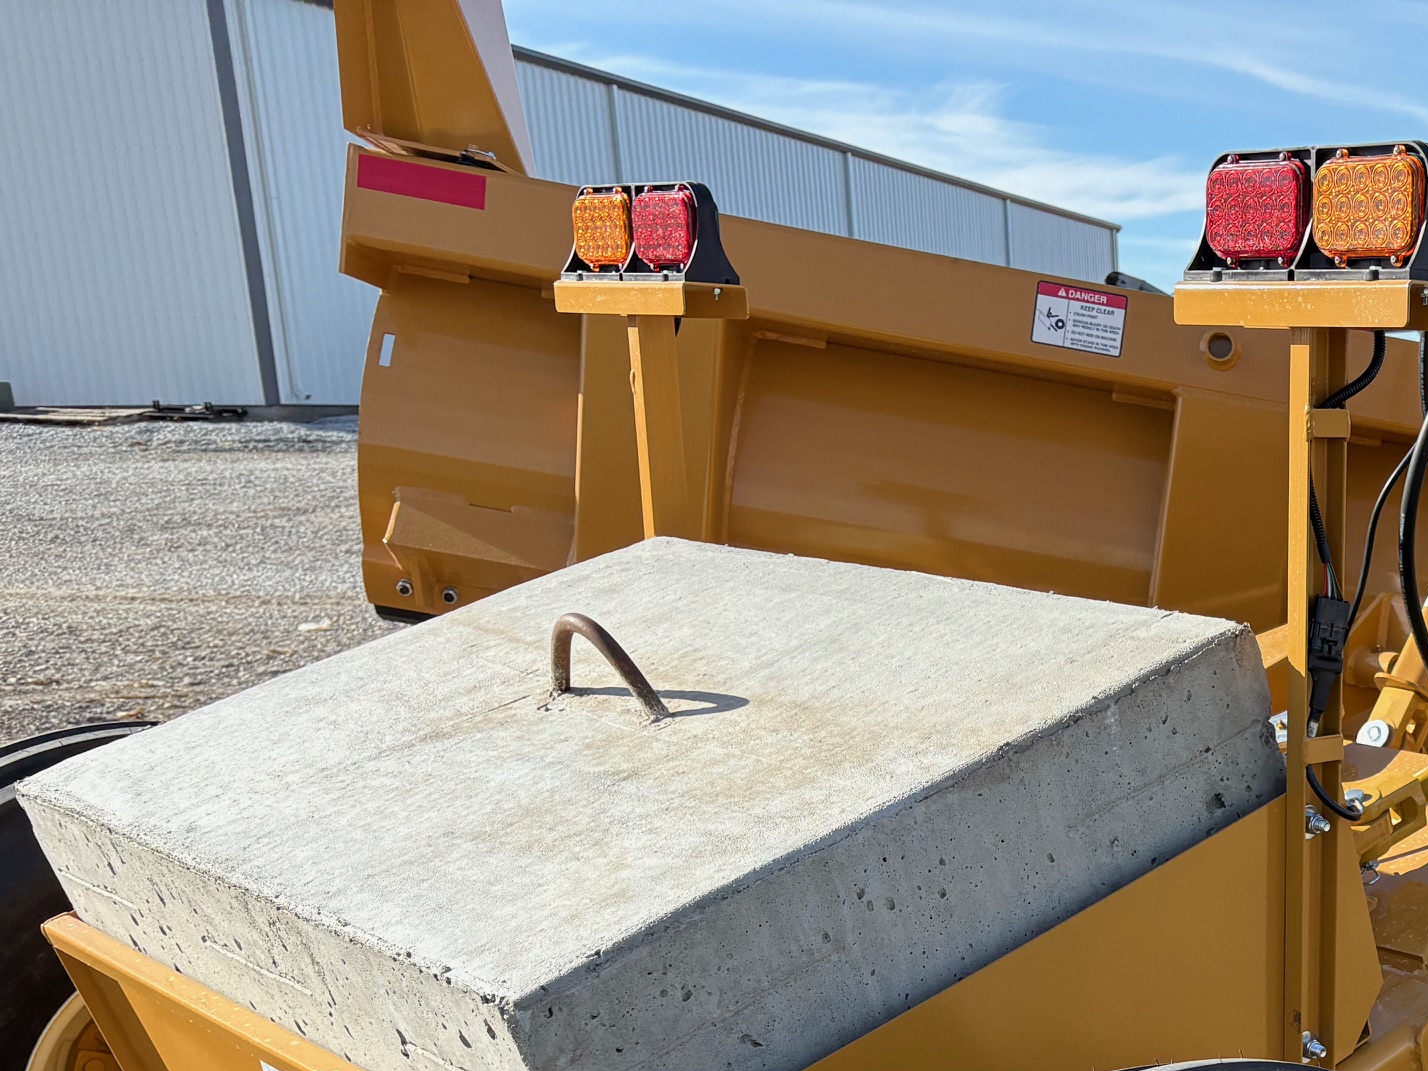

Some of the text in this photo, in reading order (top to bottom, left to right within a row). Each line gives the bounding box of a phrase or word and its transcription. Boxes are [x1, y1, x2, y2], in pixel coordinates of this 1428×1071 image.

[1069, 290, 1108, 304] DANGER
[1080, 305, 1115, 316] KEEP CLEAR
